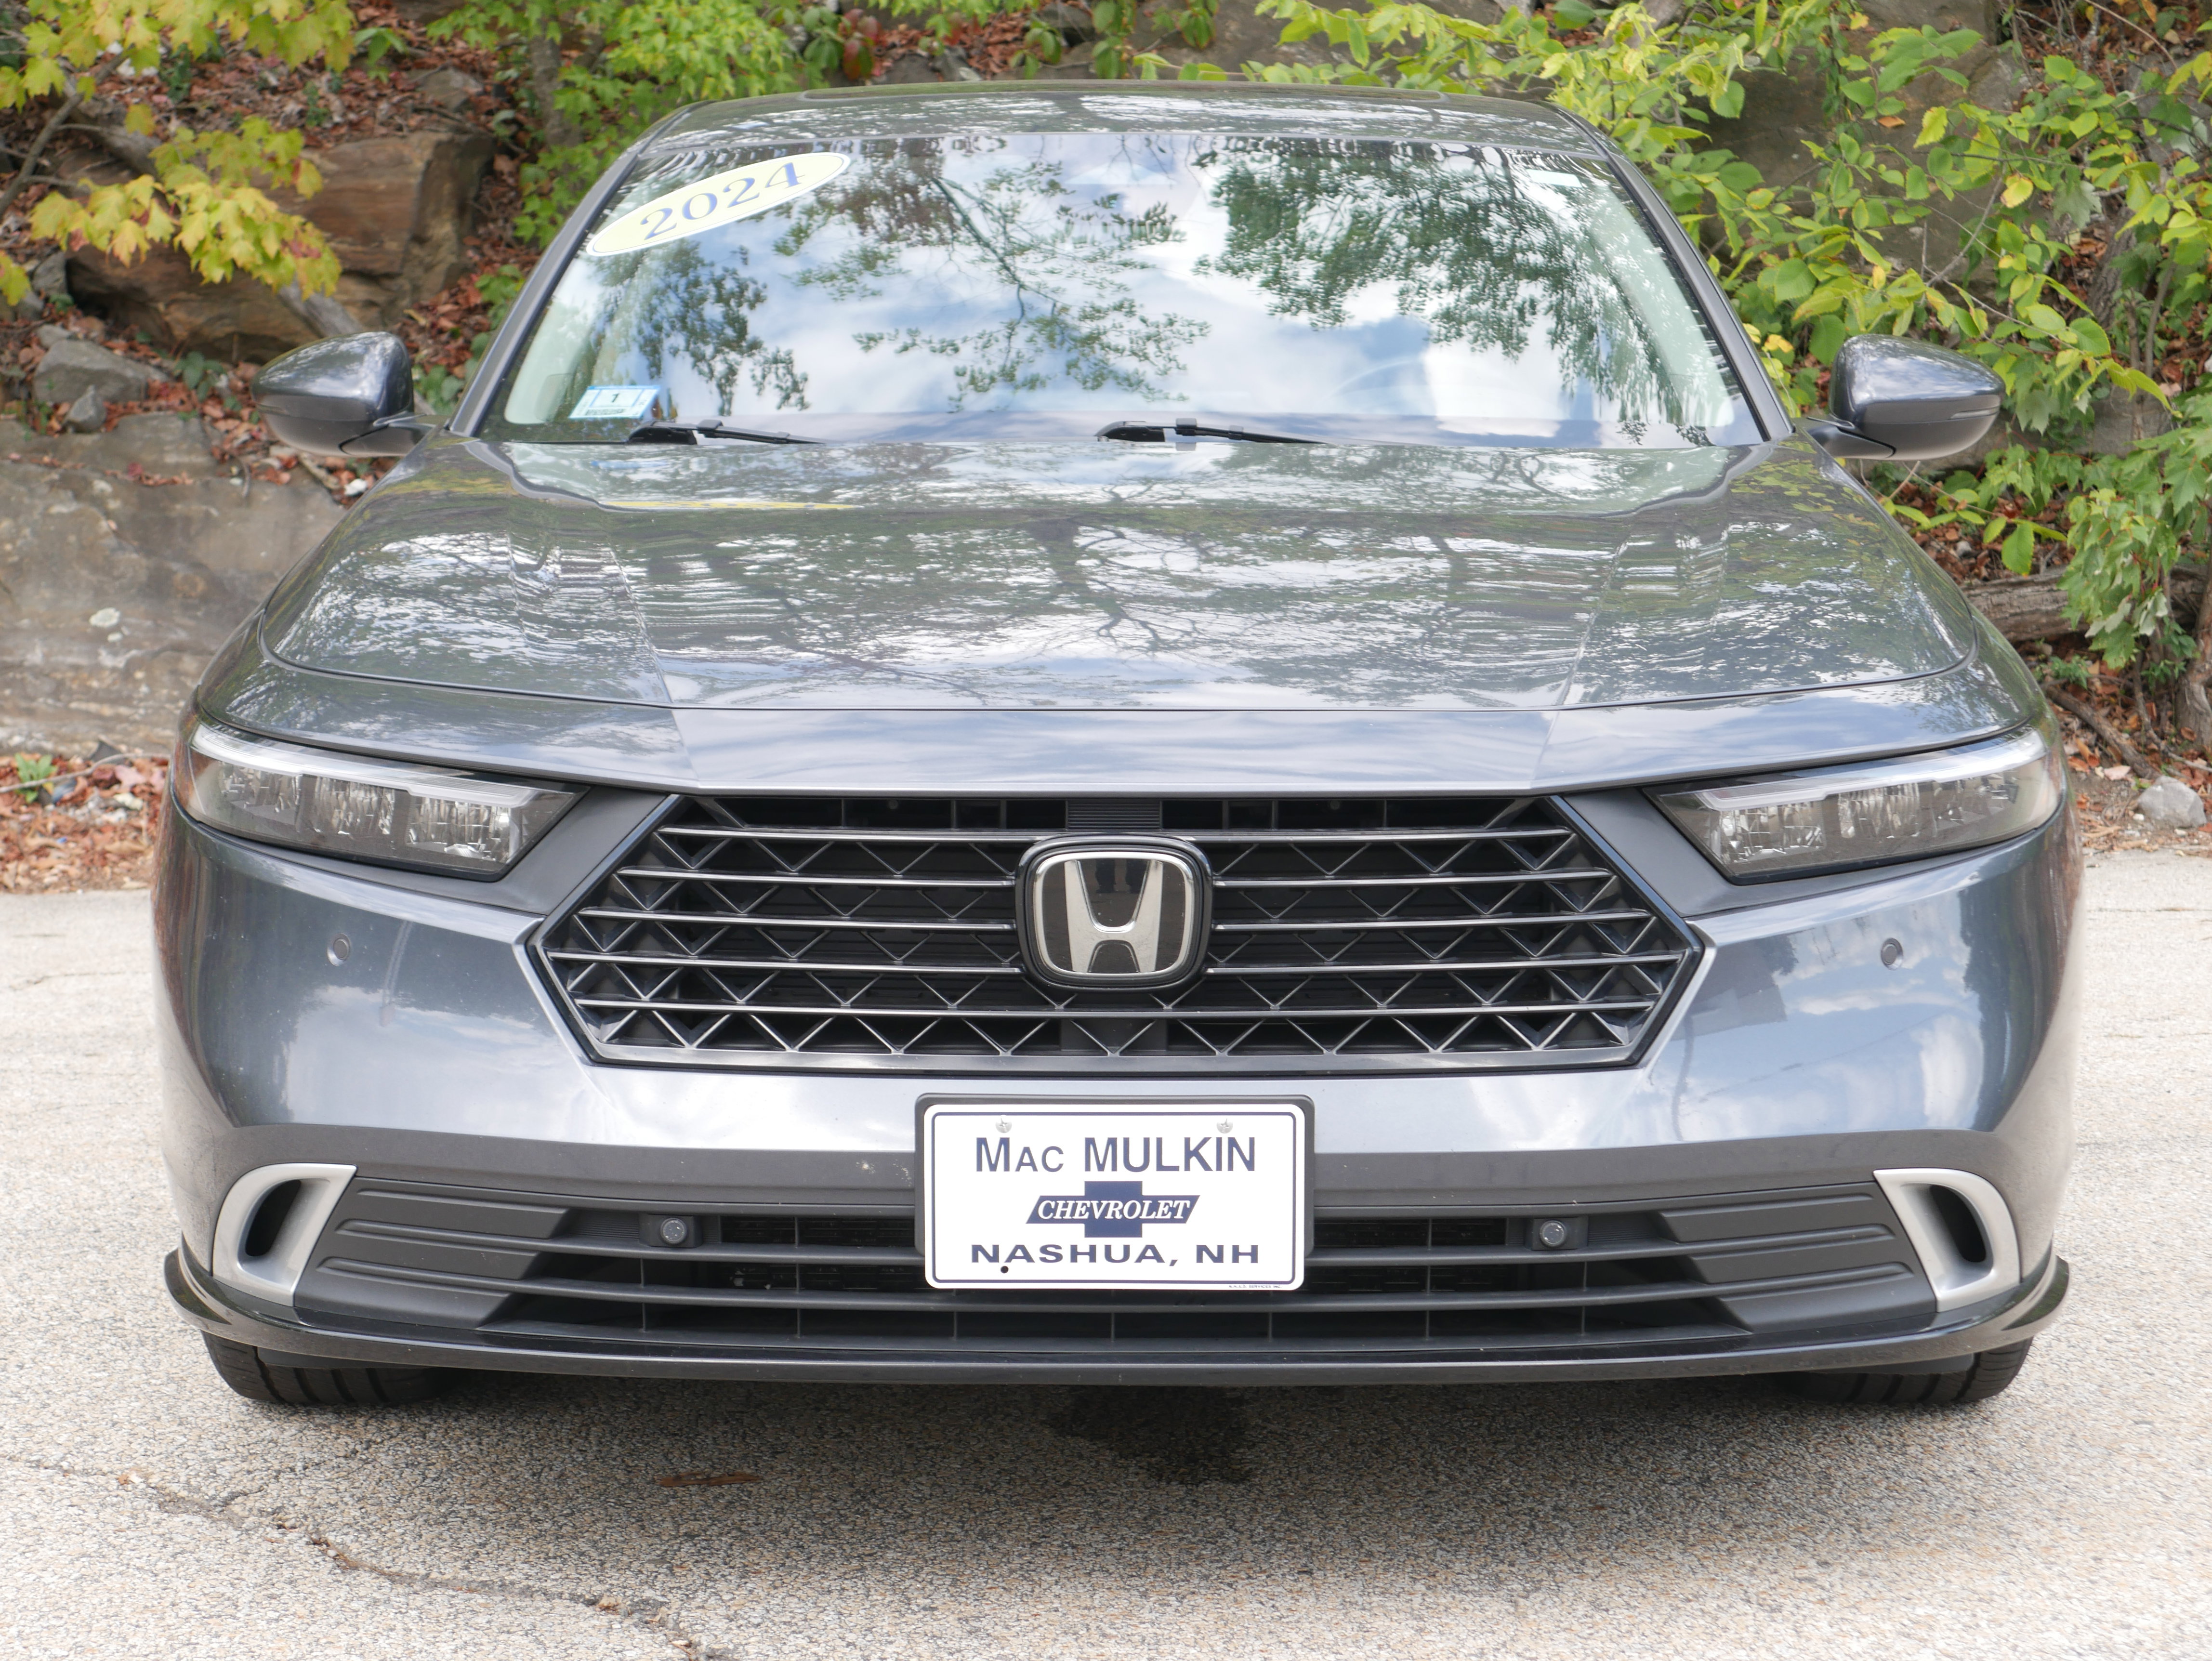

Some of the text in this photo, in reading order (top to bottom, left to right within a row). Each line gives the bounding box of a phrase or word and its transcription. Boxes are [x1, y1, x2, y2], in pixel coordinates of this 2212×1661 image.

[640, 162, 806, 241] 2024
[1084, 1136, 1255, 1173] MULKIN
[1037, 1199, 1191, 1221] CHEVROLET
[971, 1244, 1259, 1266] NASHUA, NH
